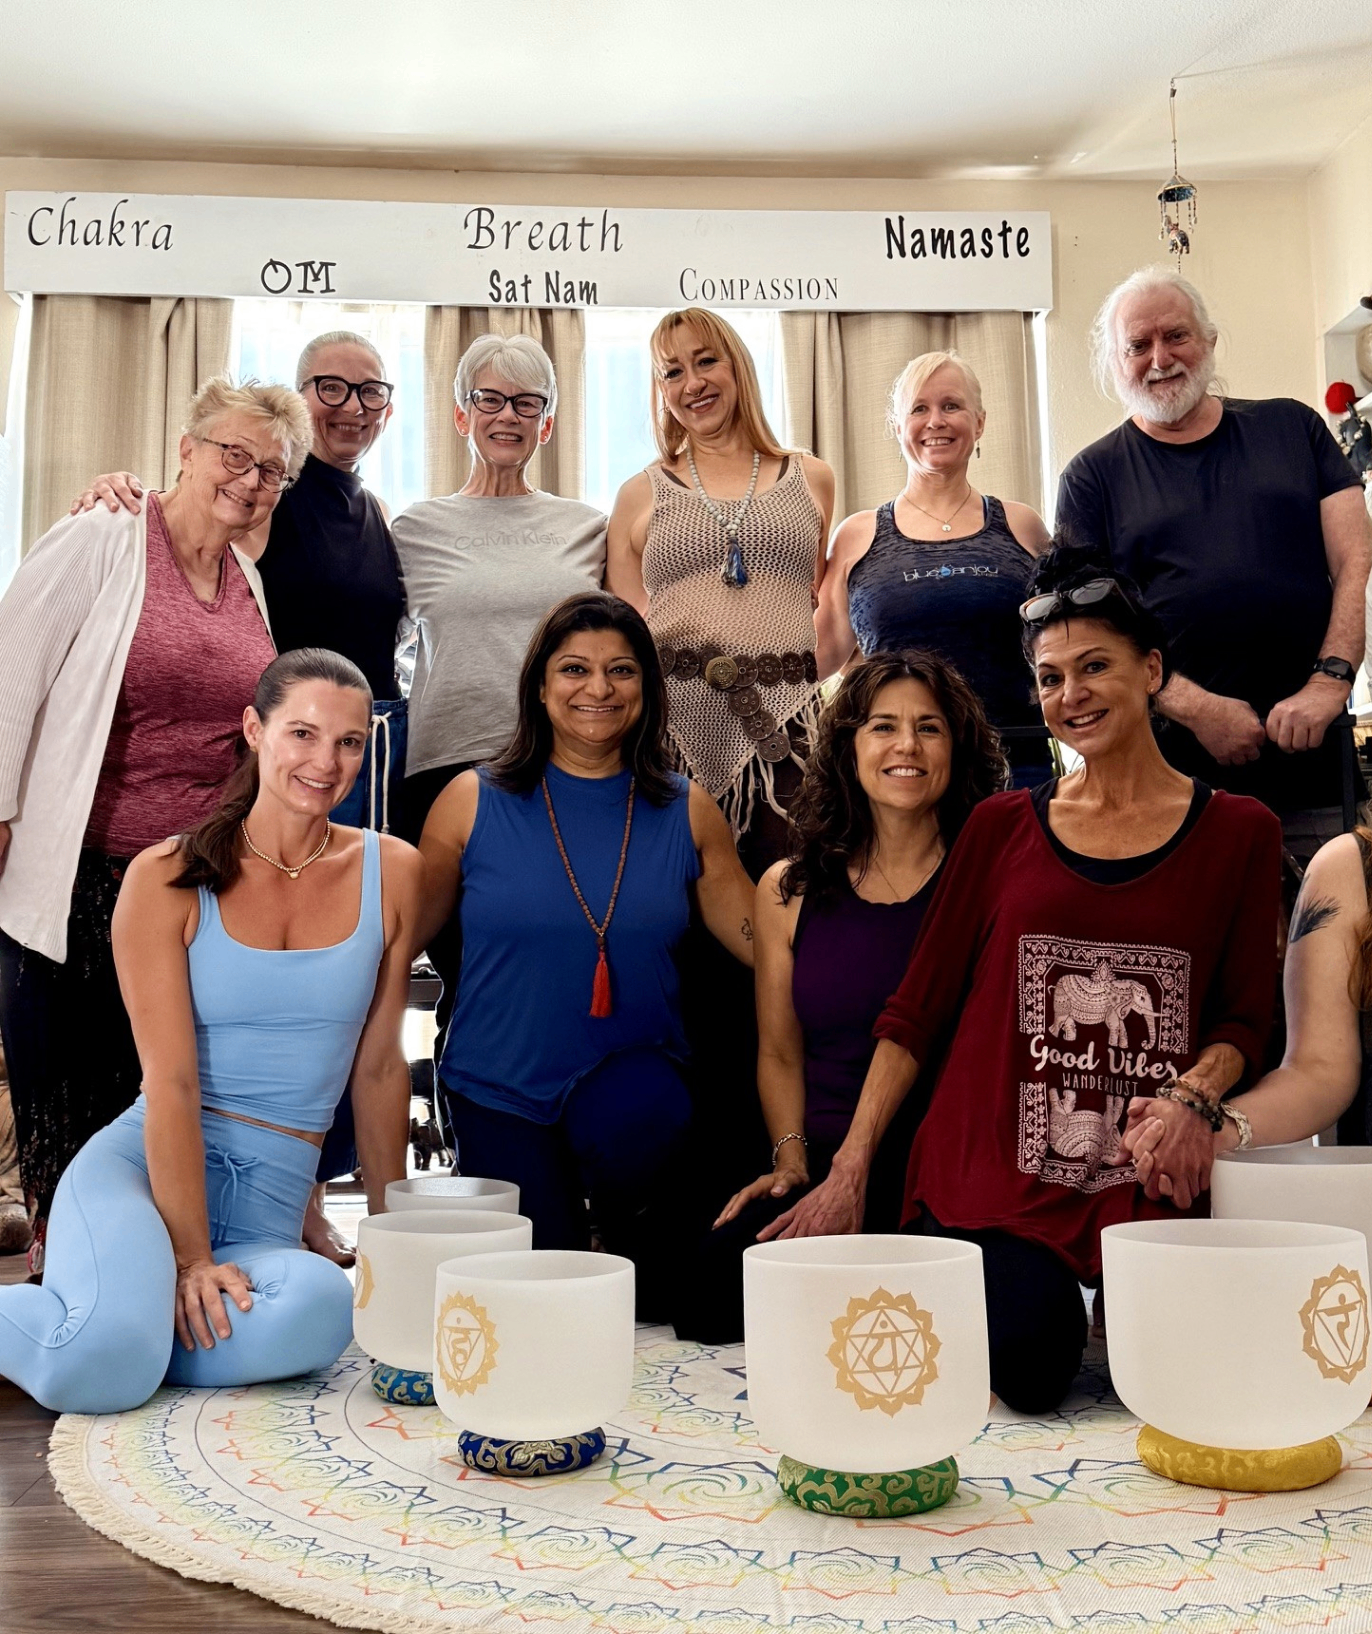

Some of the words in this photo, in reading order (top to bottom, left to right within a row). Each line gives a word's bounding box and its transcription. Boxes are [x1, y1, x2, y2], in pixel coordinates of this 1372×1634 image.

[27, 197, 174, 251] Chakra
[463, 207, 624, 253] Breath
[885, 215, 1030, 259] Namaste
[260, 258, 337, 294] OM
[488, 269, 532, 304] Sat
[544, 270, 599, 305] Nam
[454, 530, 519, 550] Calvin
[522, 530, 567, 546] Klein
[1030, 1034, 1100, 1071] Good
[1107, 1047, 1178, 1079] Vibes
[1063, 1072, 1139, 1096] WANDERLUST
